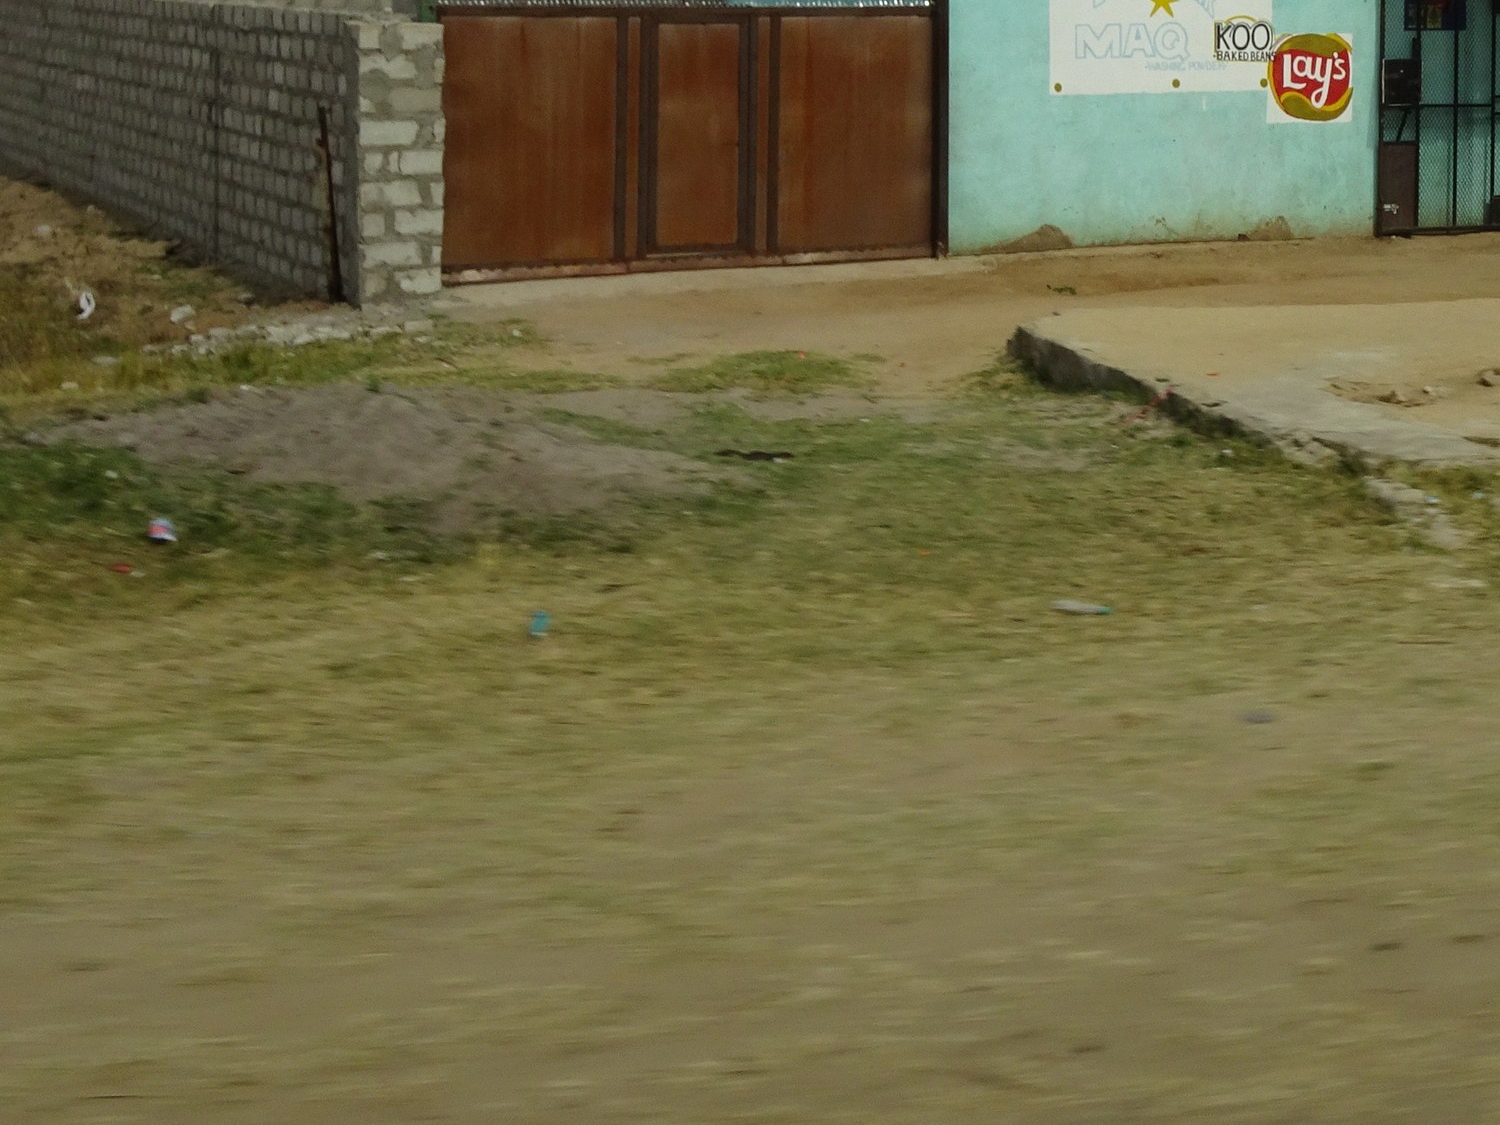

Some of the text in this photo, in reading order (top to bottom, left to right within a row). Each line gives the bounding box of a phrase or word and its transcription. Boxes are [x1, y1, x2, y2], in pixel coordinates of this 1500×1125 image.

[1074, 22, 1191, 61] MAQ
[1216, 23, 1271, 51] KOO
[1217, 51, 1249, 61] BAKED
[1282, 52, 1347, 109] Lay's
